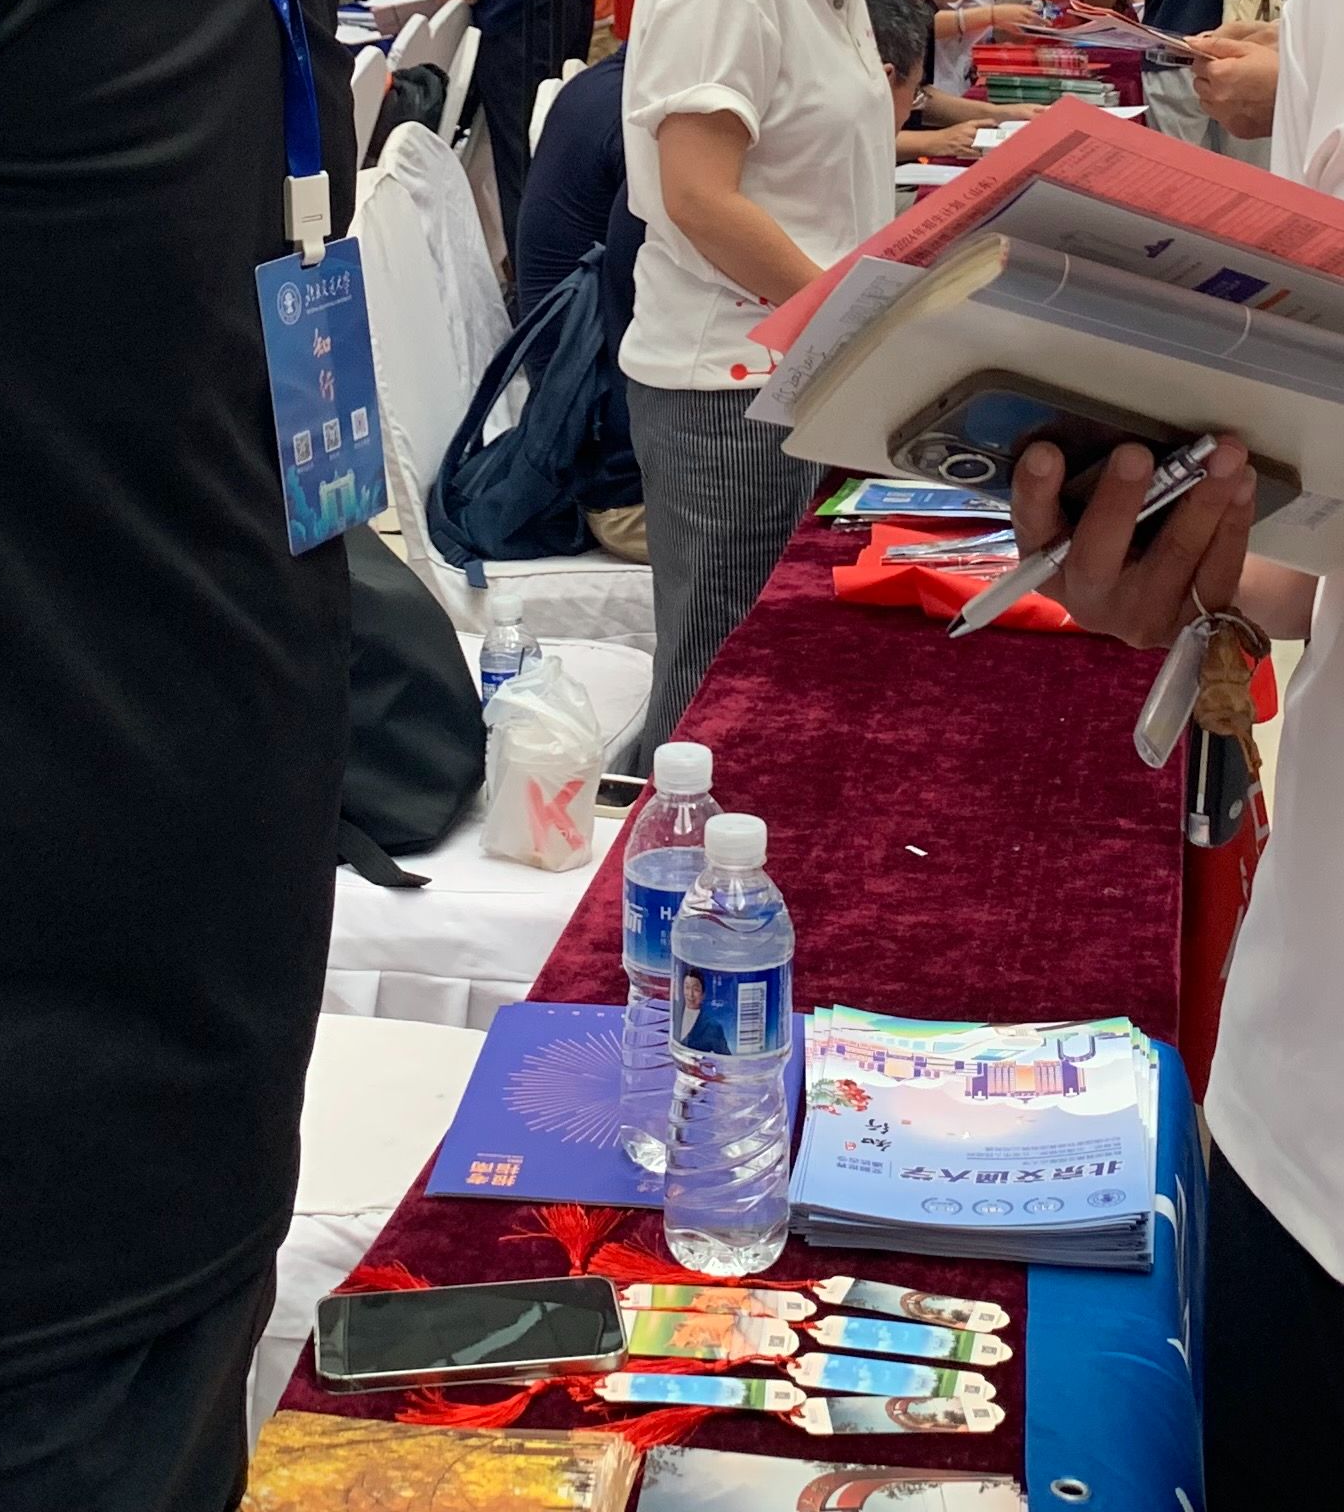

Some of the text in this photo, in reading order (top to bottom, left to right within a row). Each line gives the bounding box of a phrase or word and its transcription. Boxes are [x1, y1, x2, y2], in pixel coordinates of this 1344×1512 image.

[527, 777, 587, 853] K
[899, 1159, 1124, 1185] 北京交通大学
